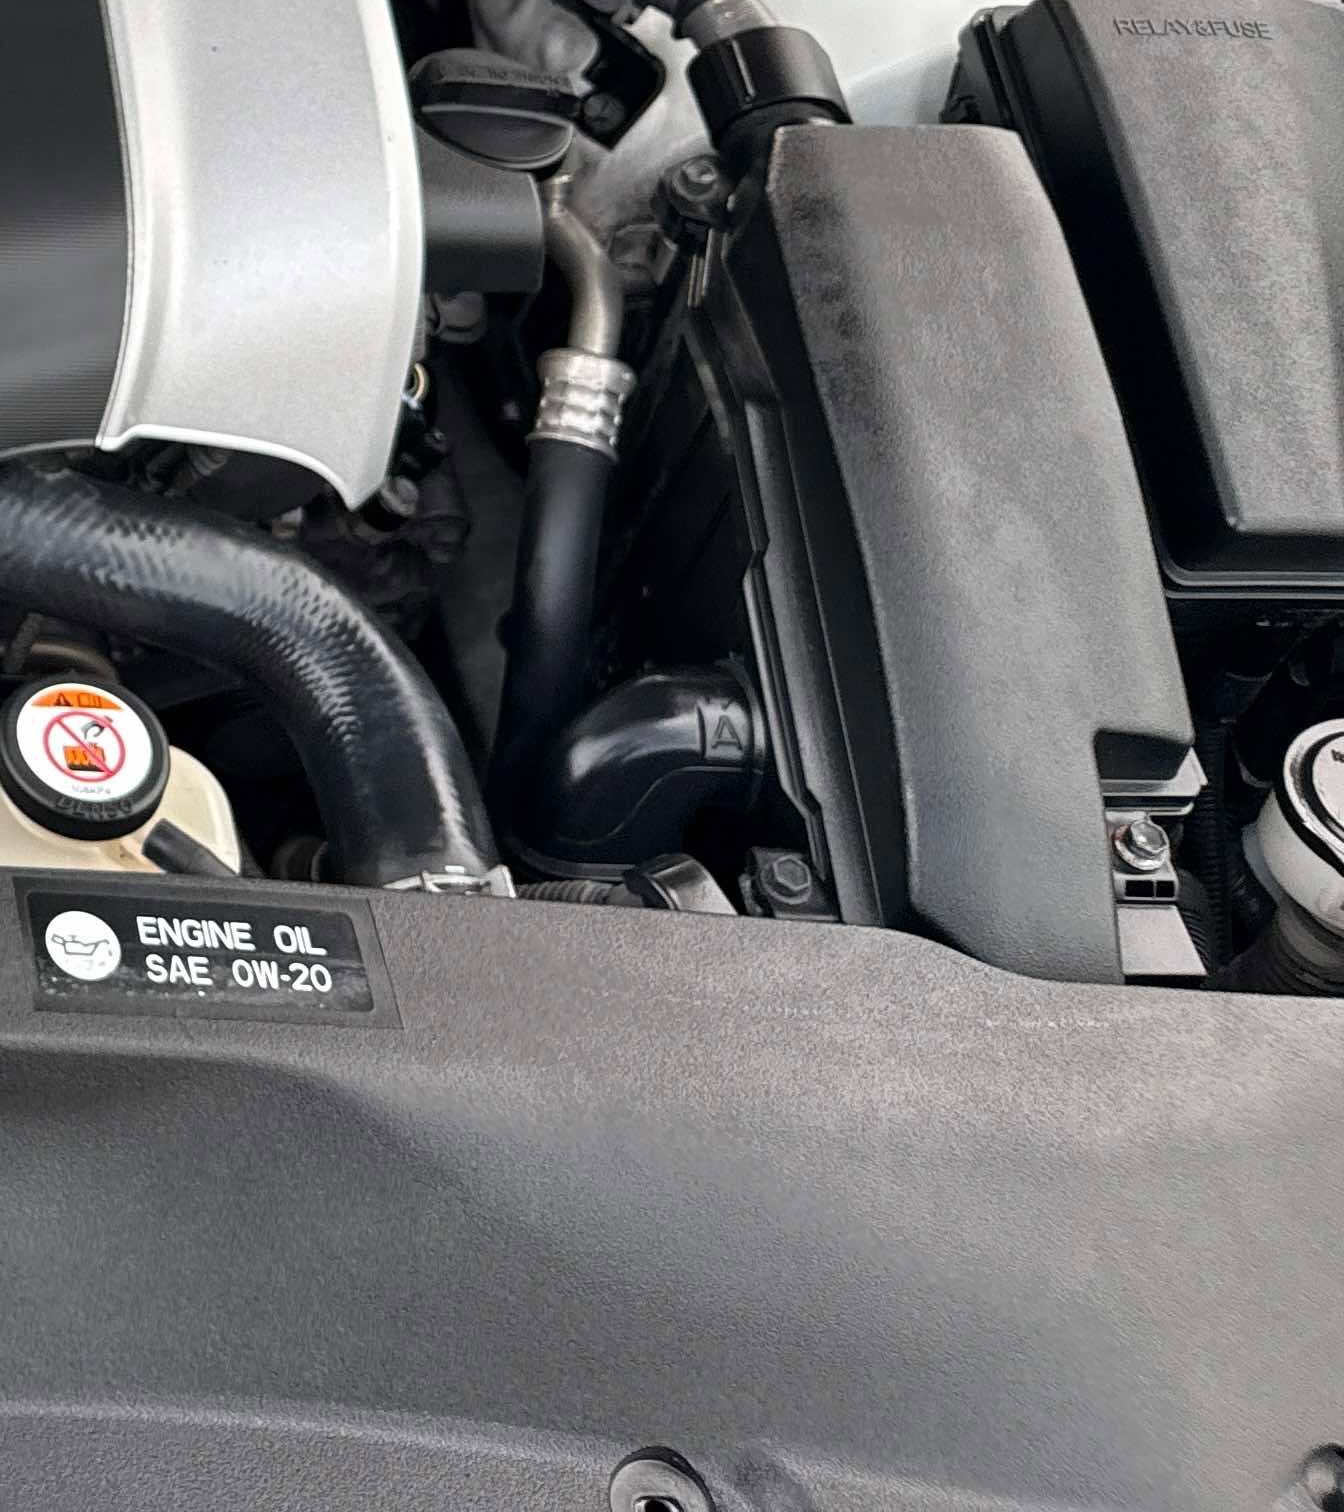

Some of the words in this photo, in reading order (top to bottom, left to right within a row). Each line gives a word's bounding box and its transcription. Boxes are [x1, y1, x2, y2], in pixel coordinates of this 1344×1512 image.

[1112, 18, 1273, 40] RELAY&FUSE
[136, 915, 256, 951] ENGINE
[273, 925, 328, 956] OIL
[145, 954, 213, 986] SAE
[232, 959, 333, 993] 0W-20
